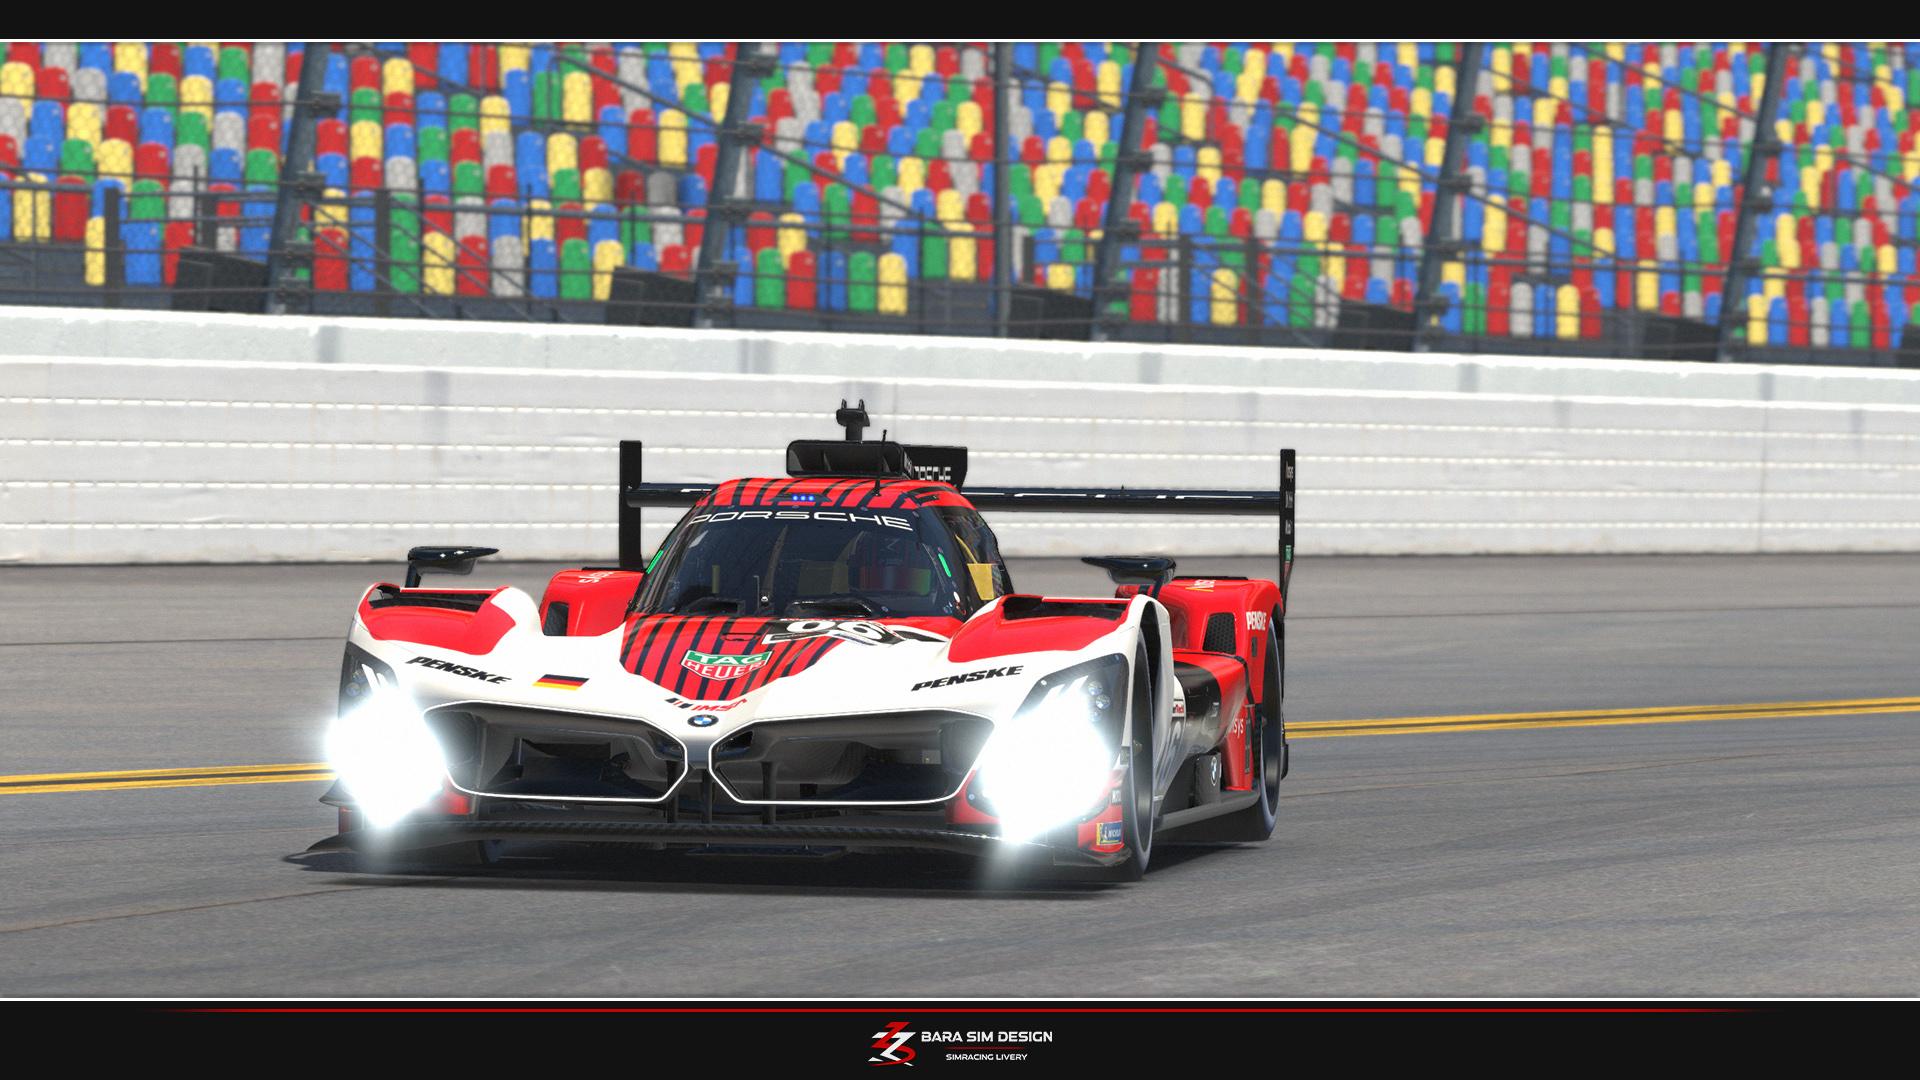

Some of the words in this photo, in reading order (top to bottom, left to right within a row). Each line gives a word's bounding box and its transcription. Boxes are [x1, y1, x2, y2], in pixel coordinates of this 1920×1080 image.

[688, 511, 913, 531] PORSCHE
[1245, 611, 1267, 631] PENSKE
[694, 653, 764, 665] TAG
[405, 655, 512, 685] PENSKE
[687, 661, 762, 678] HEUER
[911, 665, 1024, 691] PENSKE
